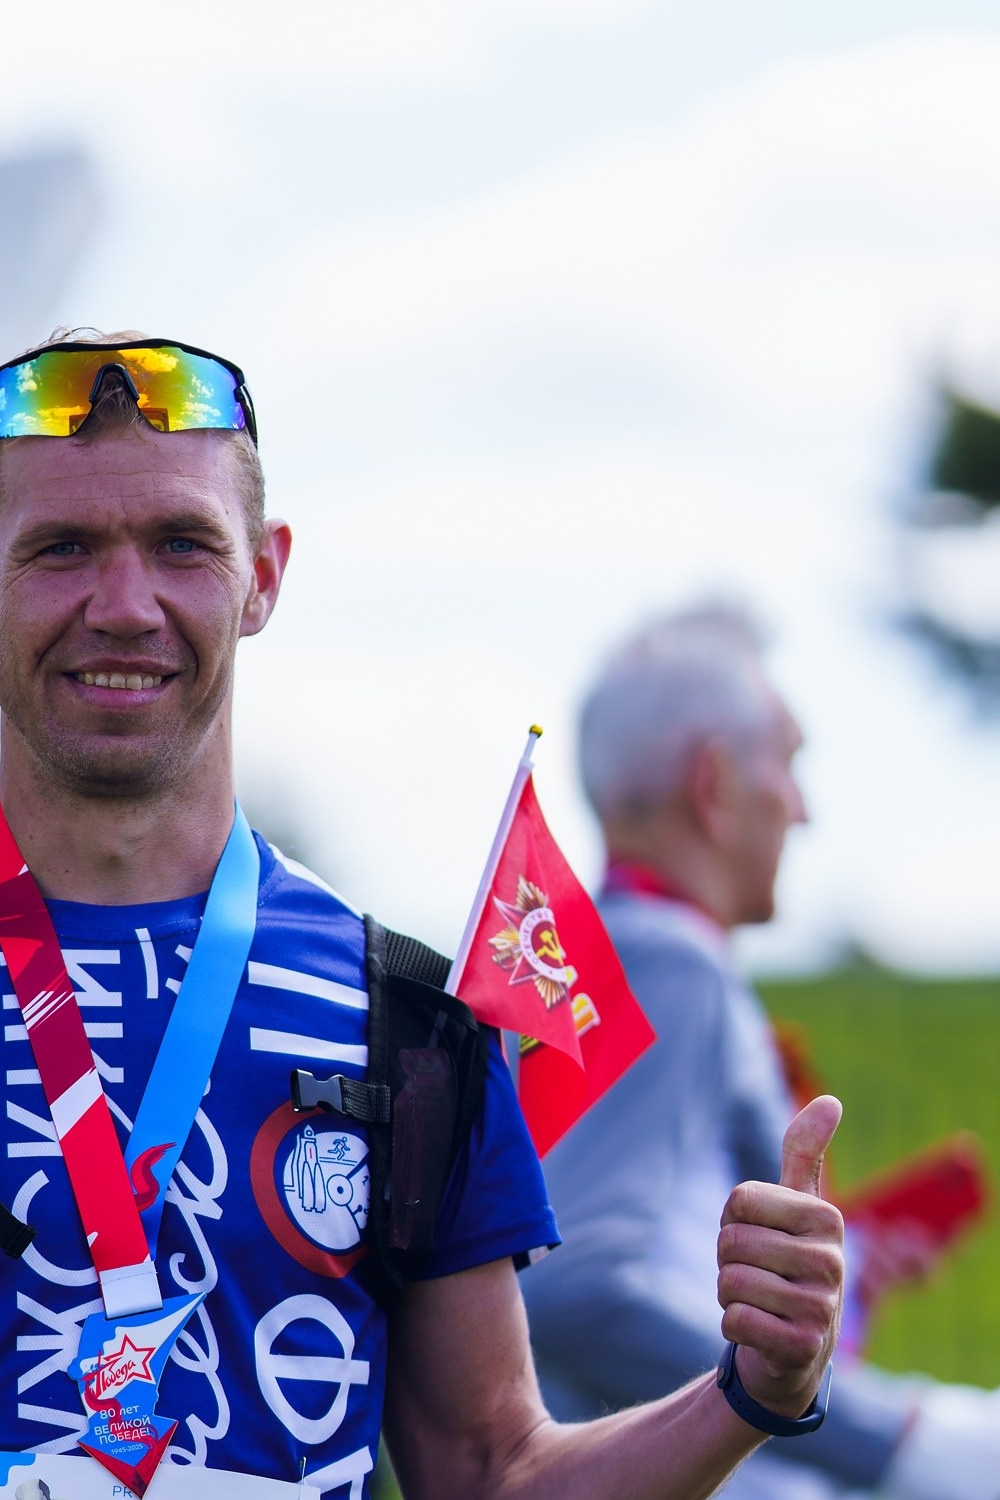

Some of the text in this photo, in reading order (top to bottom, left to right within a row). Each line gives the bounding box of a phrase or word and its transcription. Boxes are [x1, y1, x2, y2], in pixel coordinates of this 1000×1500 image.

[100, 1405, 139, 1420] 80 лет
[94, 1414, 151, 1436] ВЕЛИКОЙ
[99, 1426, 150, 1445] ПОБЕДЕ!
[111, 1443, 144, 1455] 1945-2025
